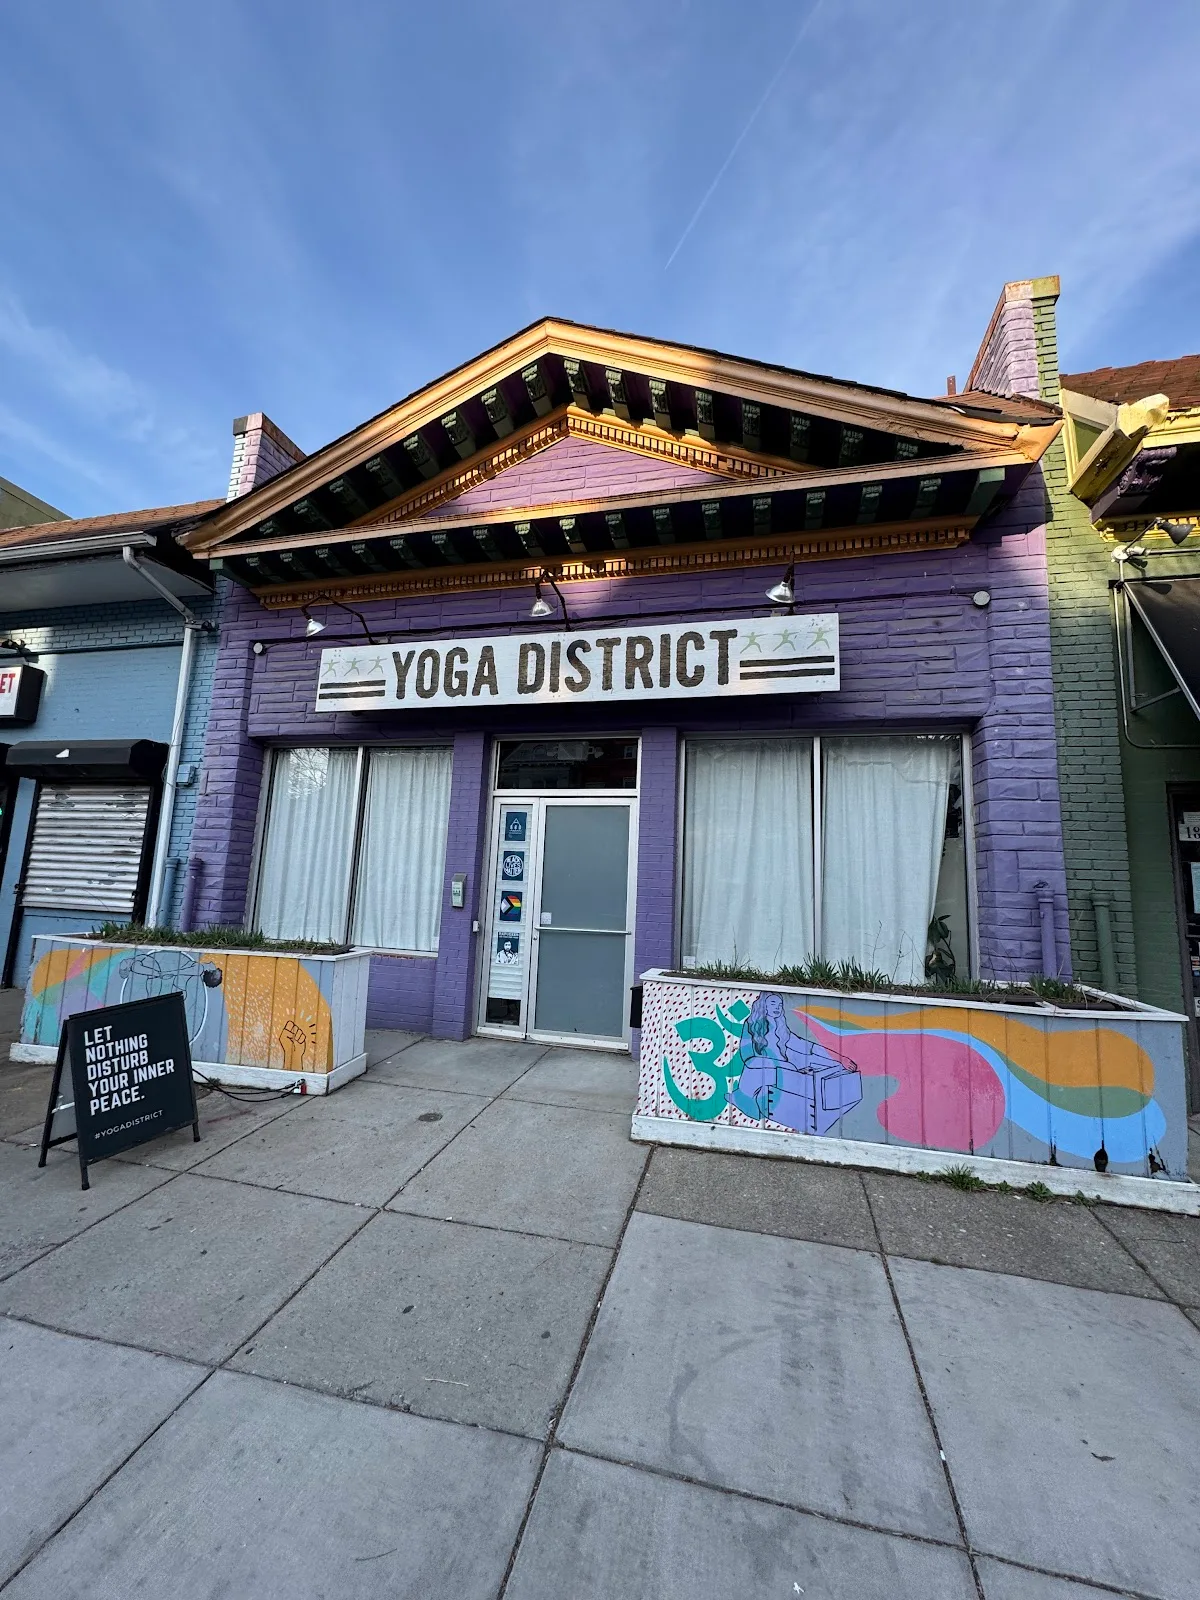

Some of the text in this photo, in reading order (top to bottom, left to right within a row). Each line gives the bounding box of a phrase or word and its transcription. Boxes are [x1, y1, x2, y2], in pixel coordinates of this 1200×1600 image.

[393, 629, 737, 699] YOGA DISTRICT
[84, 1025, 112, 1046] LET
[85, 1033, 148, 1063] NOTHING
[86, 1049, 149, 1081] DISTURB
[88, 1059, 175, 1098] YOUR INNER
[89, 1085, 145, 1116] PEACE.
[94, 1110, 164, 1139] #YOGADISTRICT
